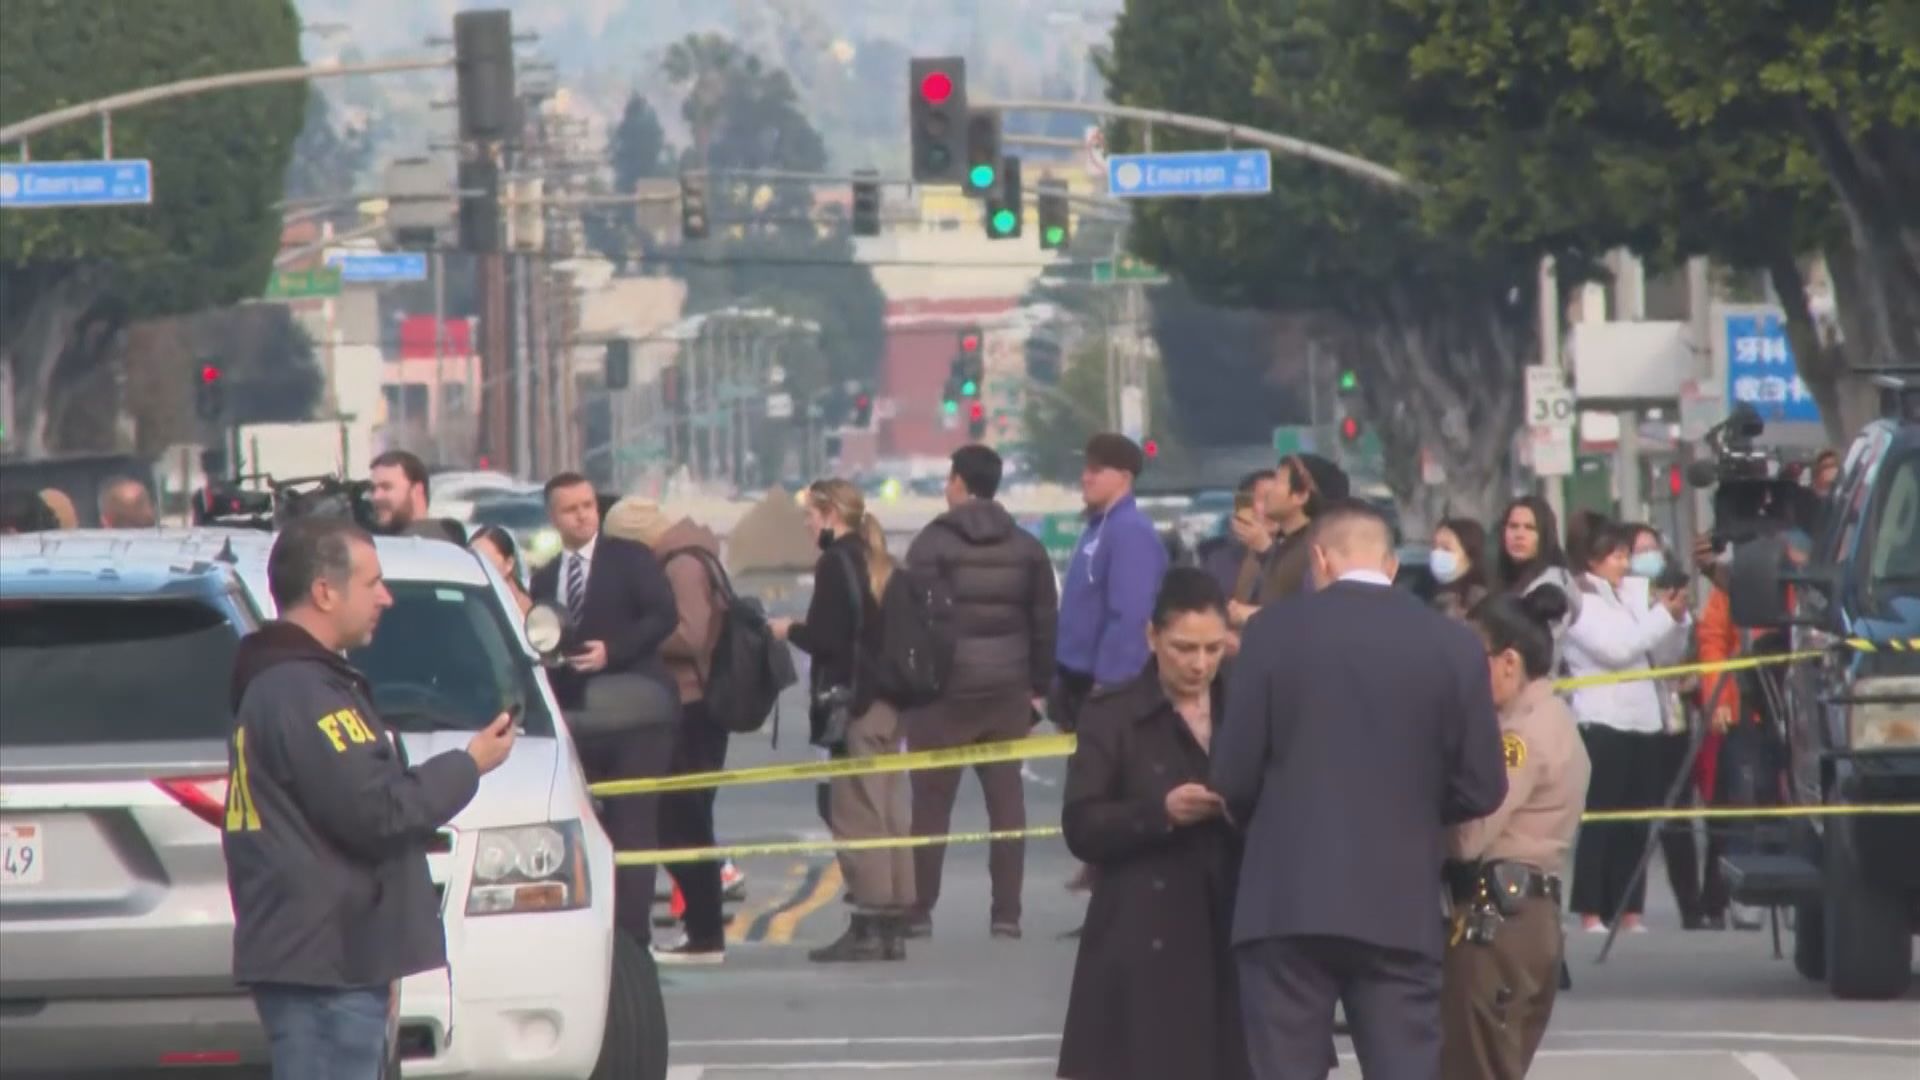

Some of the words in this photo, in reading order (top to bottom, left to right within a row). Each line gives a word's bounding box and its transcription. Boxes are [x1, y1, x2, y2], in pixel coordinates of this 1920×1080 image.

[23, 174, 104, 196] Emerson
[1147, 166, 1225, 186] Emerson
[1535, 398, 1570, 420] 30
[317, 708, 376, 752] FBI
